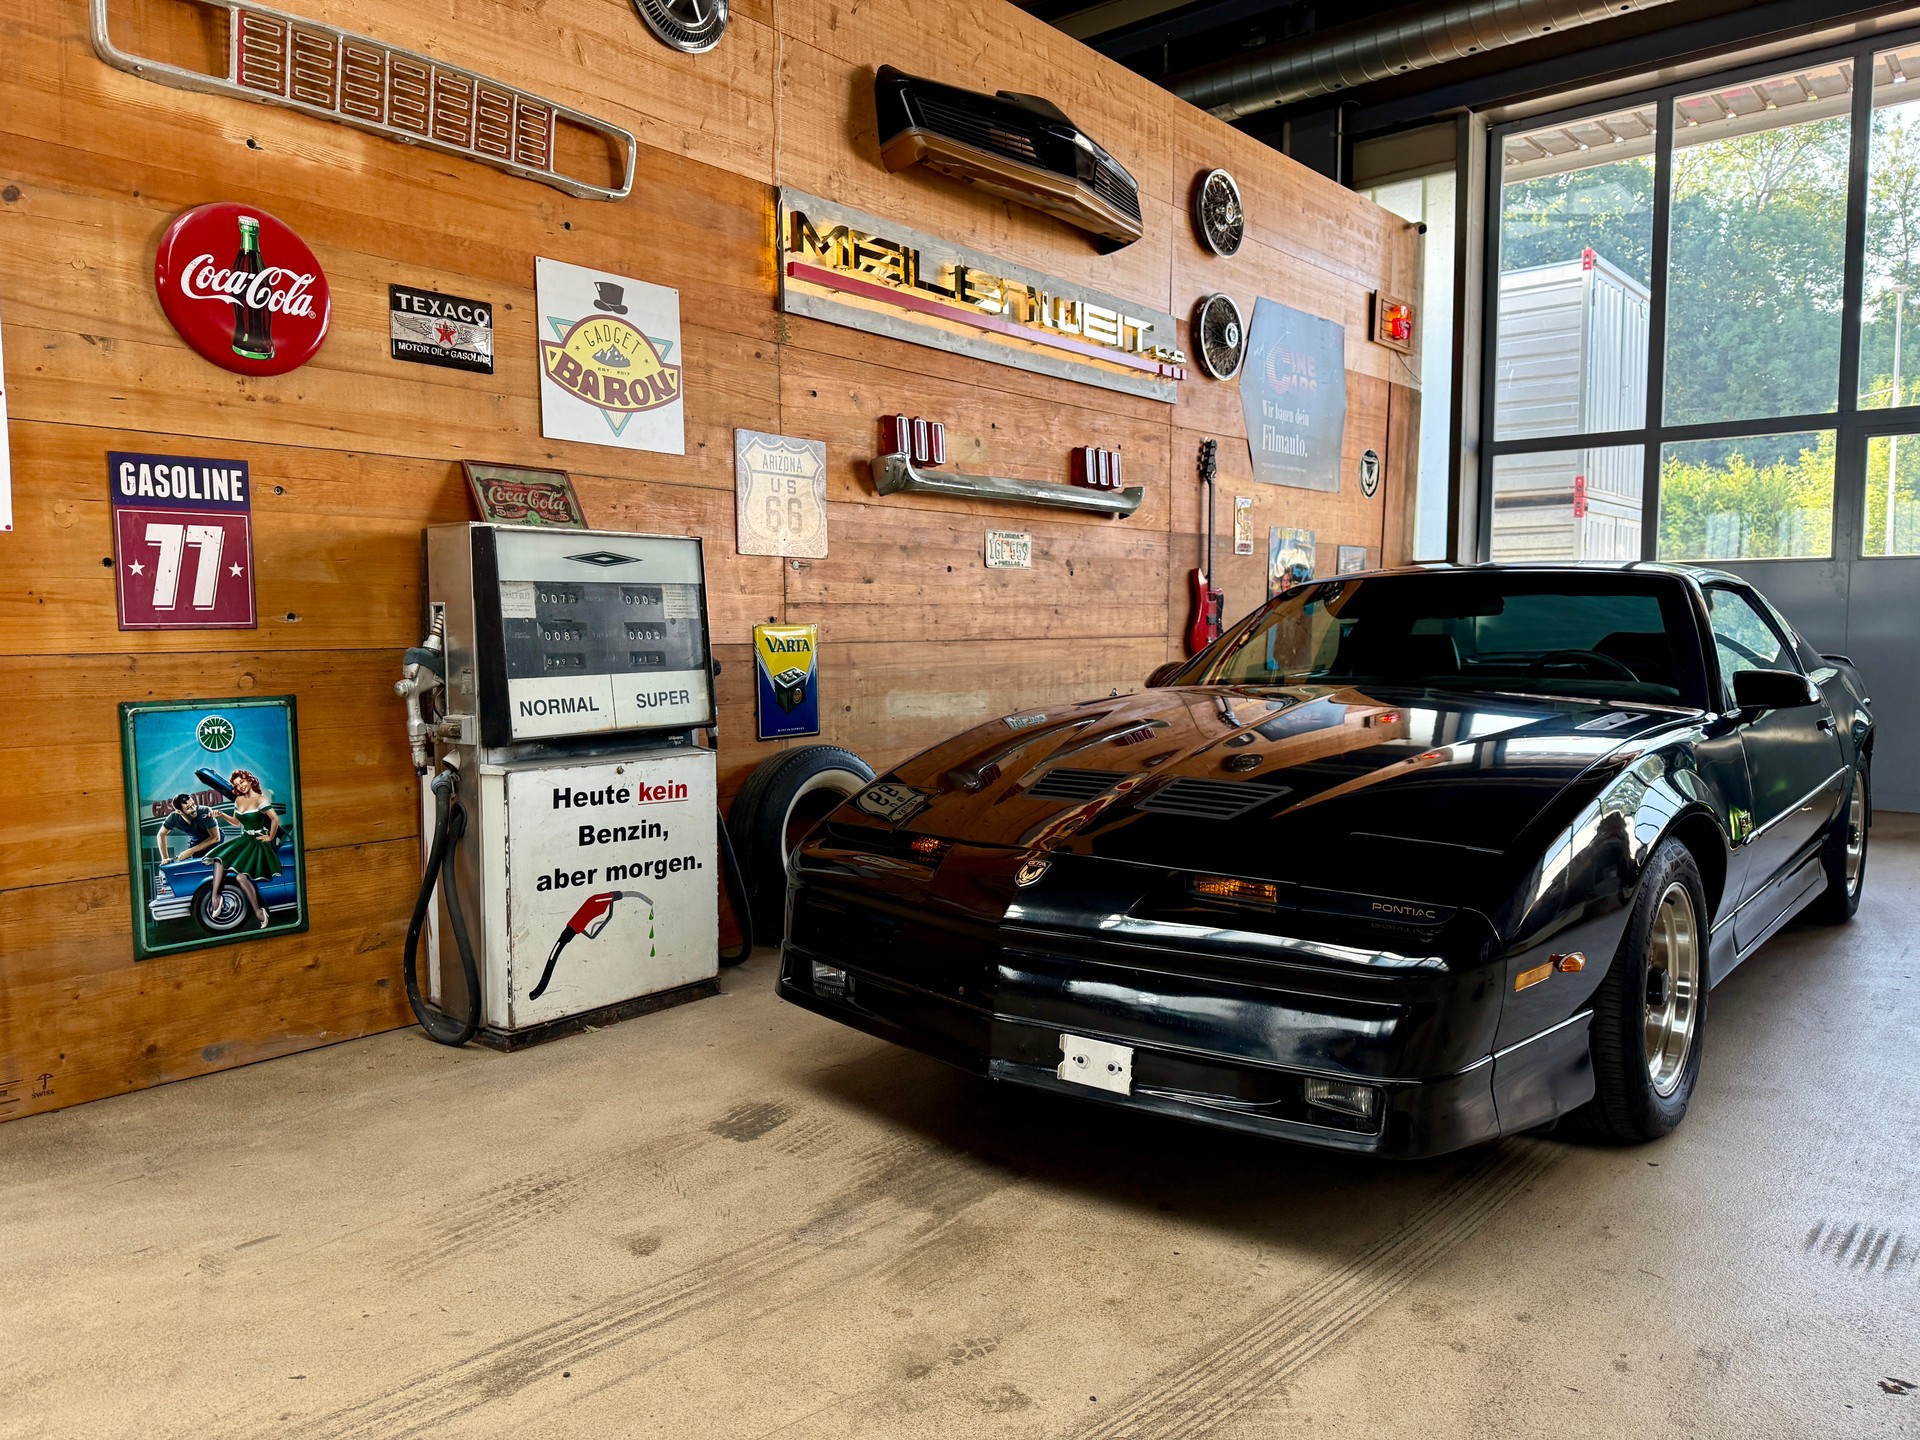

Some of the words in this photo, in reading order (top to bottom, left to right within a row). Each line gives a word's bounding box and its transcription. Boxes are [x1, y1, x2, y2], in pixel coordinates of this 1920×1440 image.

[180, 253, 315, 319] Coca-Cola
[395, 293, 489, 326] TEXACO
[398, 341, 429, 354] MOTOR
[431, 347, 444, 356] OIL
[583, 324, 642, 354] GADGET
[551, 350, 676, 407] BARON
[1261, 400, 1275, 420] Wir
[1294, 409, 1309, 427] dein
[1261, 424, 1308, 458] Filmauto.
[762, 454, 803, 473] ARIZONA
[119, 461, 244, 502] GASOLINE
[488, 486, 566, 511] Coca-Cola
[765, 495, 803, 534] 66
[144, 523, 226, 610] 77
[765, 636, 811, 653] VARTA
[519, 696, 600, 717] NORMAL
[636, 689, 690, 709] SUPER
[204, 725, 227, 735] NTK
[552, 784, 630, 809] Heute
[638, 780, 689, 803] kein
[578, 819, 669, 847] Benzin,
[536, 868, 598, 891] aber
[605, 854, 703, 880] morgen.
[1372, 902, 1436, 919] PONTIAC
